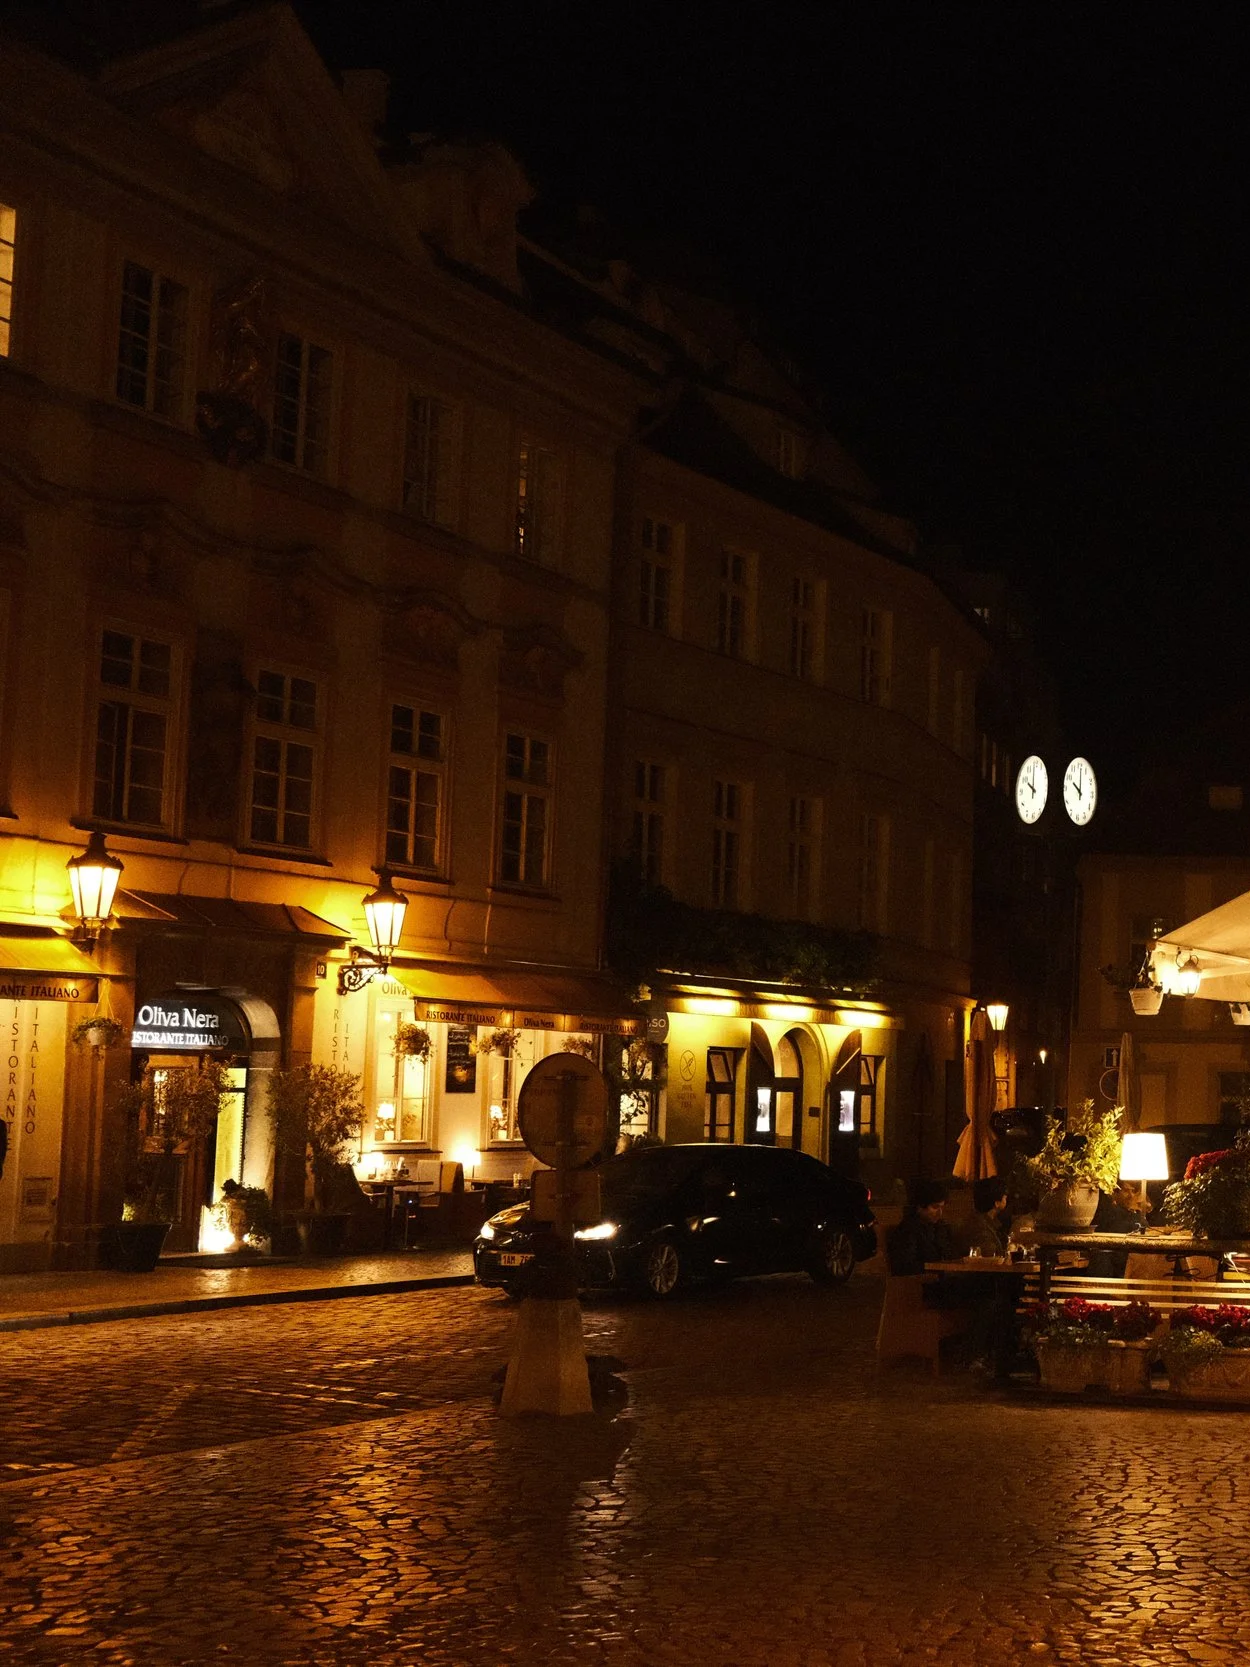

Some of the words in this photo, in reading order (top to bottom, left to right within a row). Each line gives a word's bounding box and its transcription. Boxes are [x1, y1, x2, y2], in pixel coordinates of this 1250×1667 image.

[30, 985, 79, 998] ITALIANO
[381, 982, 407, 996] Oliva
[138, 1005, 180, 1027] Oliva
[182, 1008, 219, 1028] Nera
[426, 1010, 465, 1022] RISTORANTE
[466, 1013, 496, 1024] ITALIANO
[523, 1017, 540, 1028] Oliva
[540, 1019, 555, 1029] Nera
[185, 1033, 230, 1046] ITALIANO
